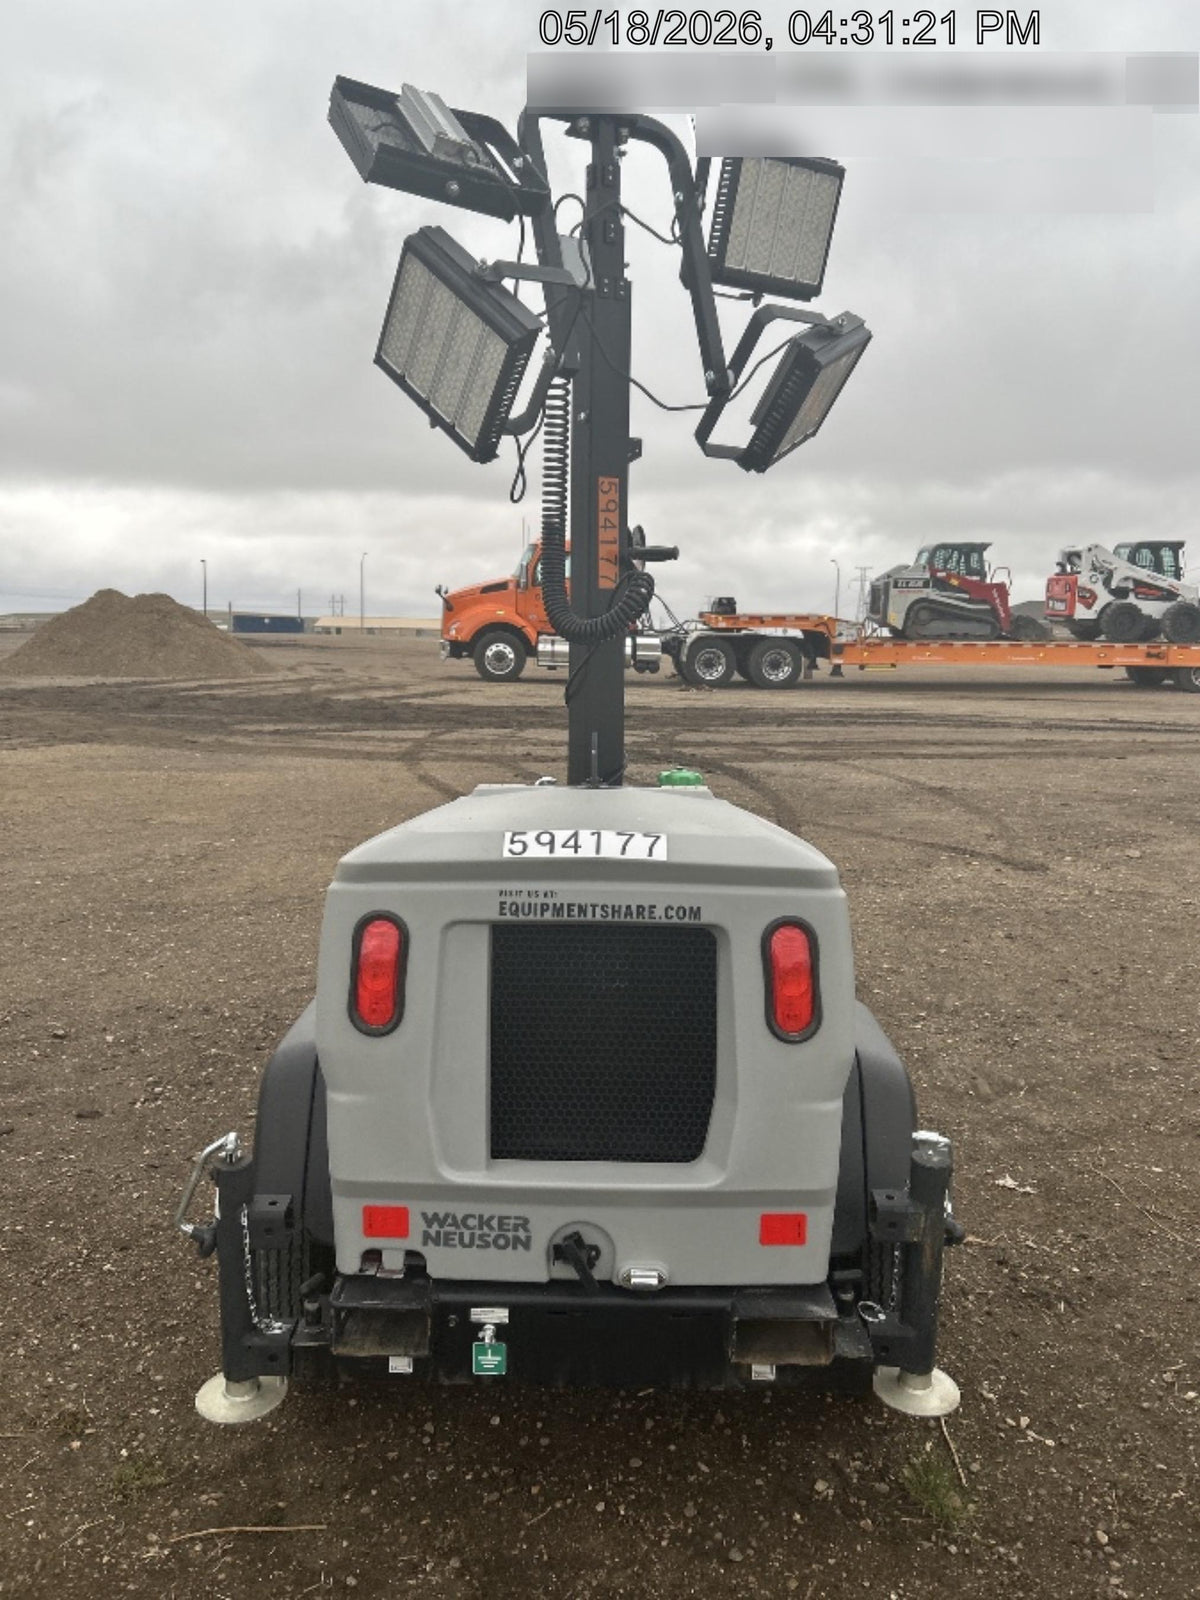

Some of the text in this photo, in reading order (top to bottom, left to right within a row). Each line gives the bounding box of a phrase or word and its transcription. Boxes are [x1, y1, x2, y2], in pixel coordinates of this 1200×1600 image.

[600, 480, 618, 585] 594177
[507, 831, 662, 858] 594177
[527, 889, 540, 899] US
[498, 900, 702, 921] EQUIPMENTSHARE.COM
[420, 1211, 531, 1233] WACKER
[421, 1230, 532, 1251] NEUSON
